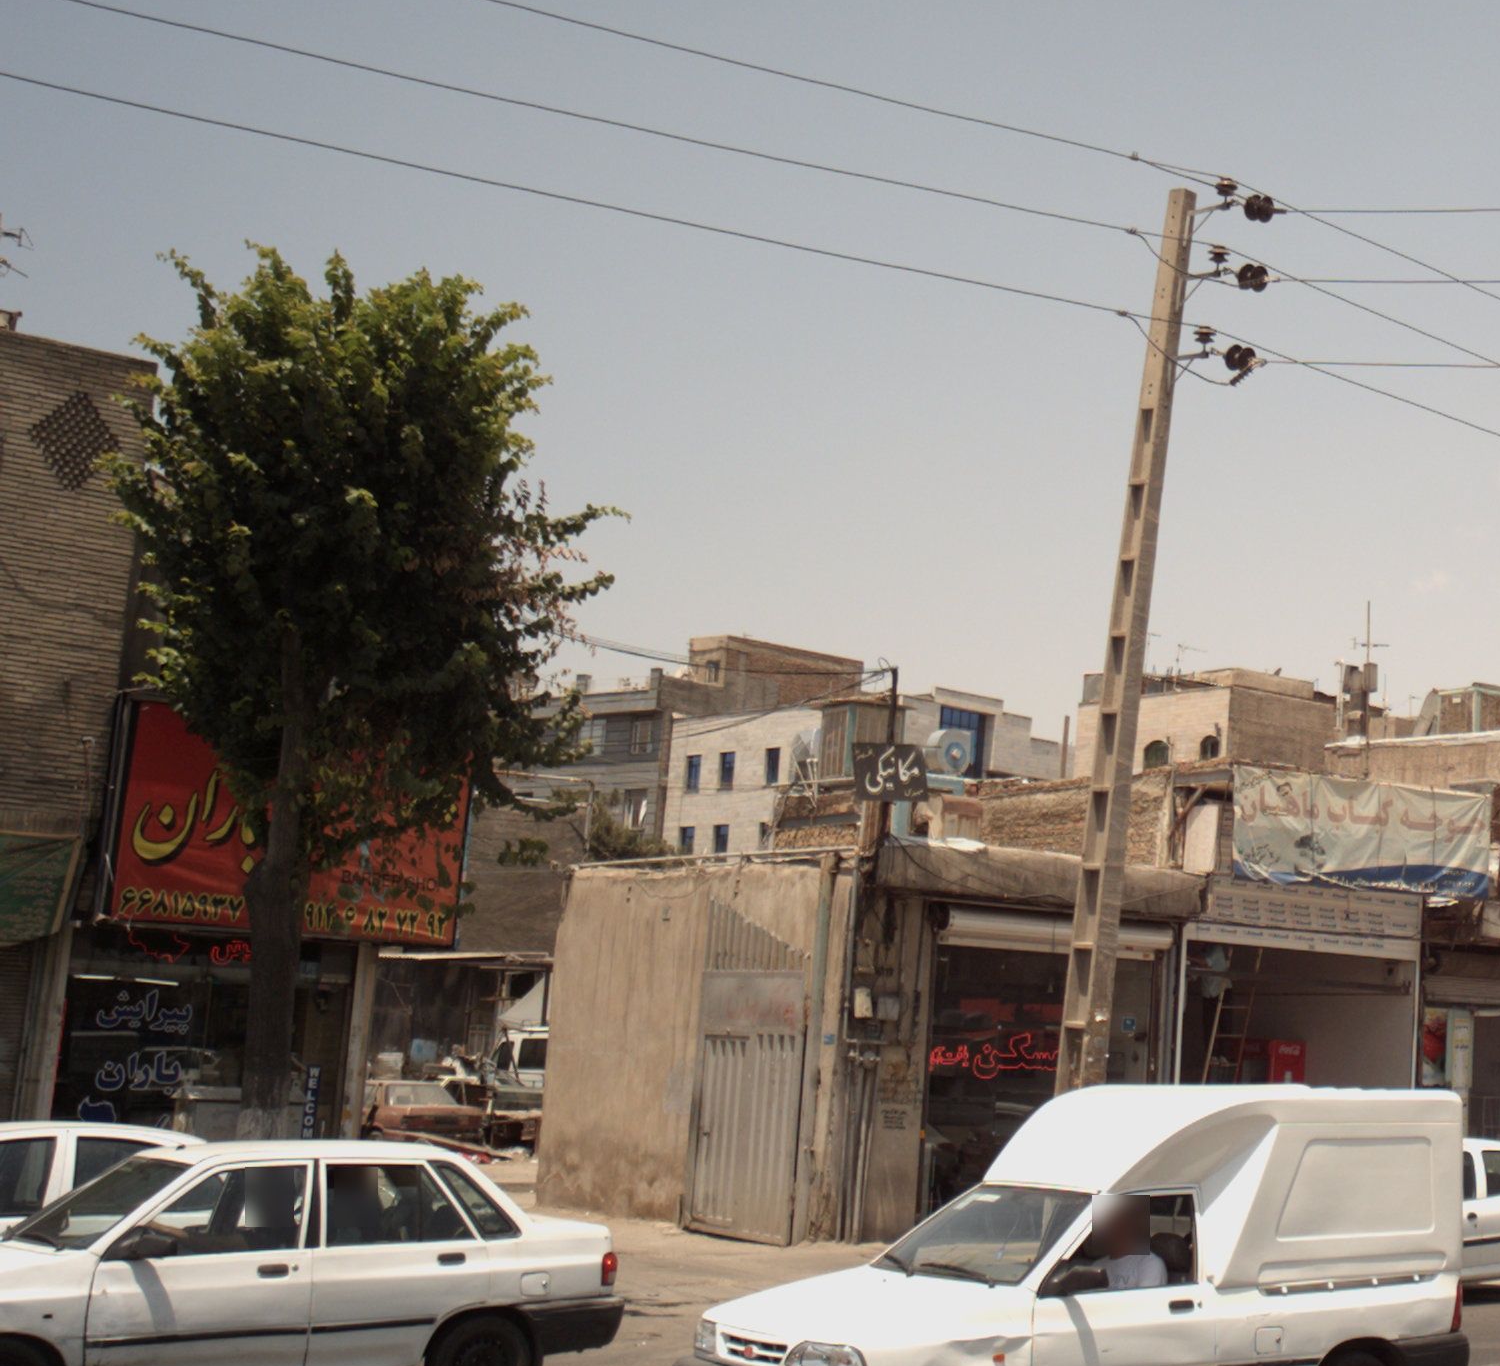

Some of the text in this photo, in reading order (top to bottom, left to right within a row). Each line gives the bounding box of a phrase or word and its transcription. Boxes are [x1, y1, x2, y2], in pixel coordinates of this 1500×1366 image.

[865, 745, 920, 795] مکانیکی
[132, 768, 257, 875] اران
[96, 989, 193, 1034] پیرایش
[95, 1050, 181, 1096] باران
[302, 1066, 322, 1139] WELCOM
